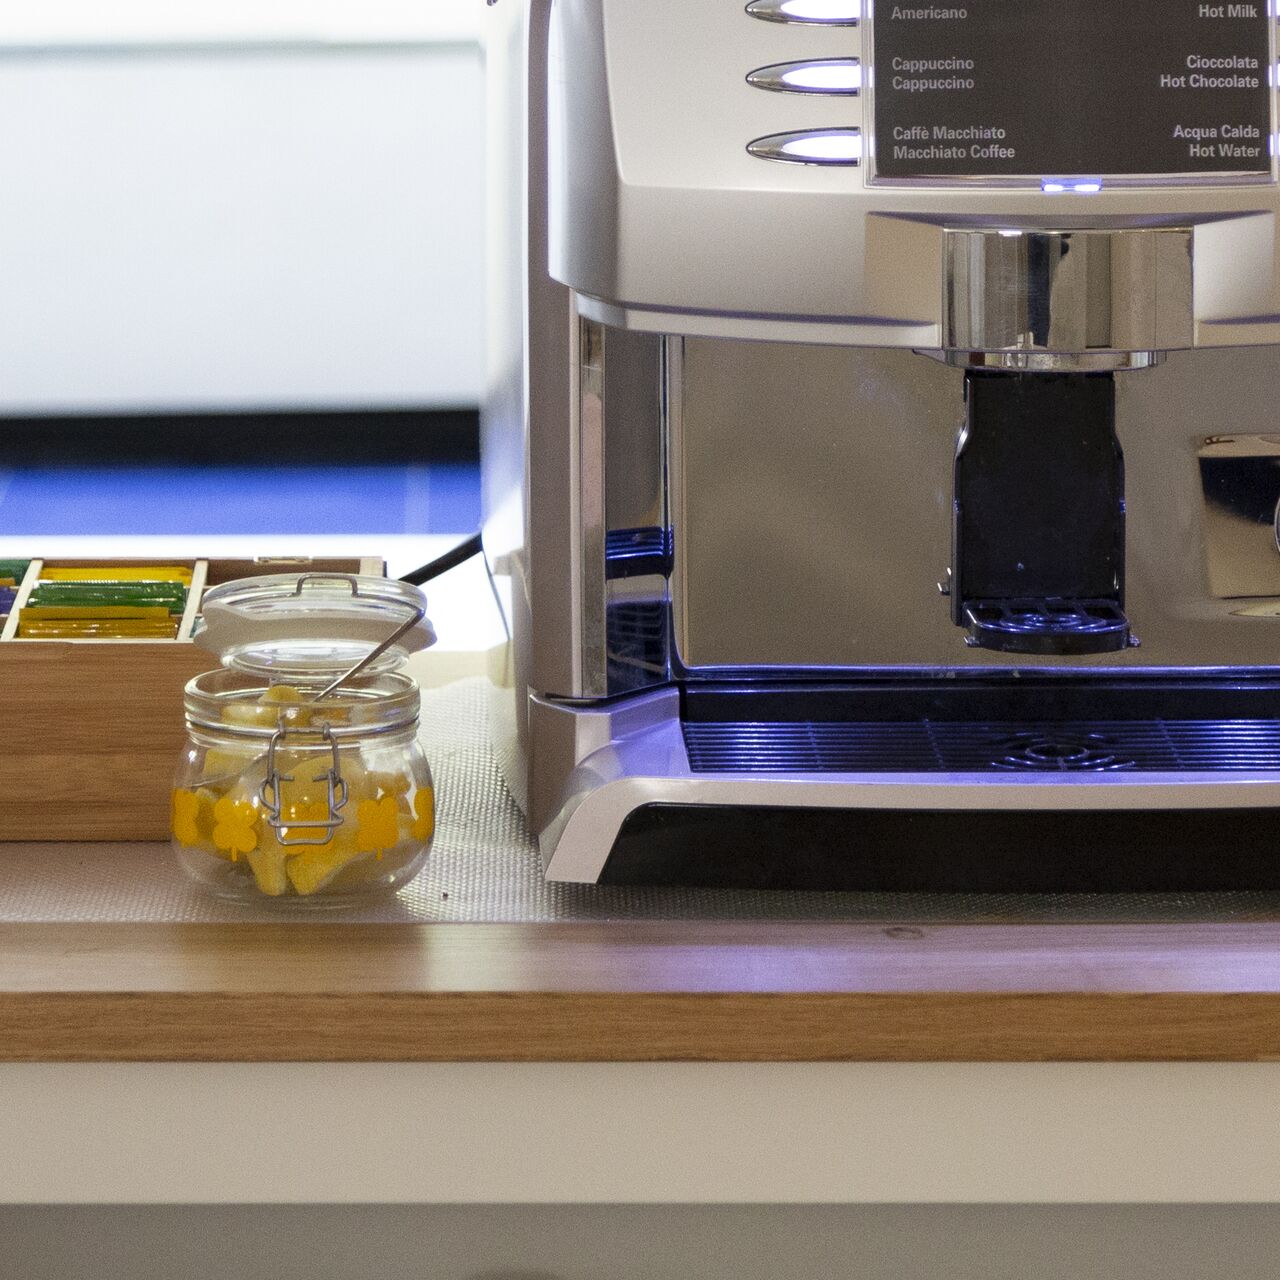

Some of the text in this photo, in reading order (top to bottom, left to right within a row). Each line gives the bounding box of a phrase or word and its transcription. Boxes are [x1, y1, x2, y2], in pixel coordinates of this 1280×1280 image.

[891, 6, 967, 19] Americano
[1198, 4, 1257, 18] Hot Milk
[892, 57, 974, 73] Cappuccino
[1186, 55, 1258, 69] Cioccolata
[892, 76, 974, 93] Cappuccino
[1160, 75, 1259, 88] Hot Chocolate
[893, 126, 1006, 139] Caffè Macchiato
[1173, 125, 1260, 140] Acqua Calda
[893, 145, 1015, 159] Macchiato Coffee
[1189, 144, 1260, 158] Hot Water
